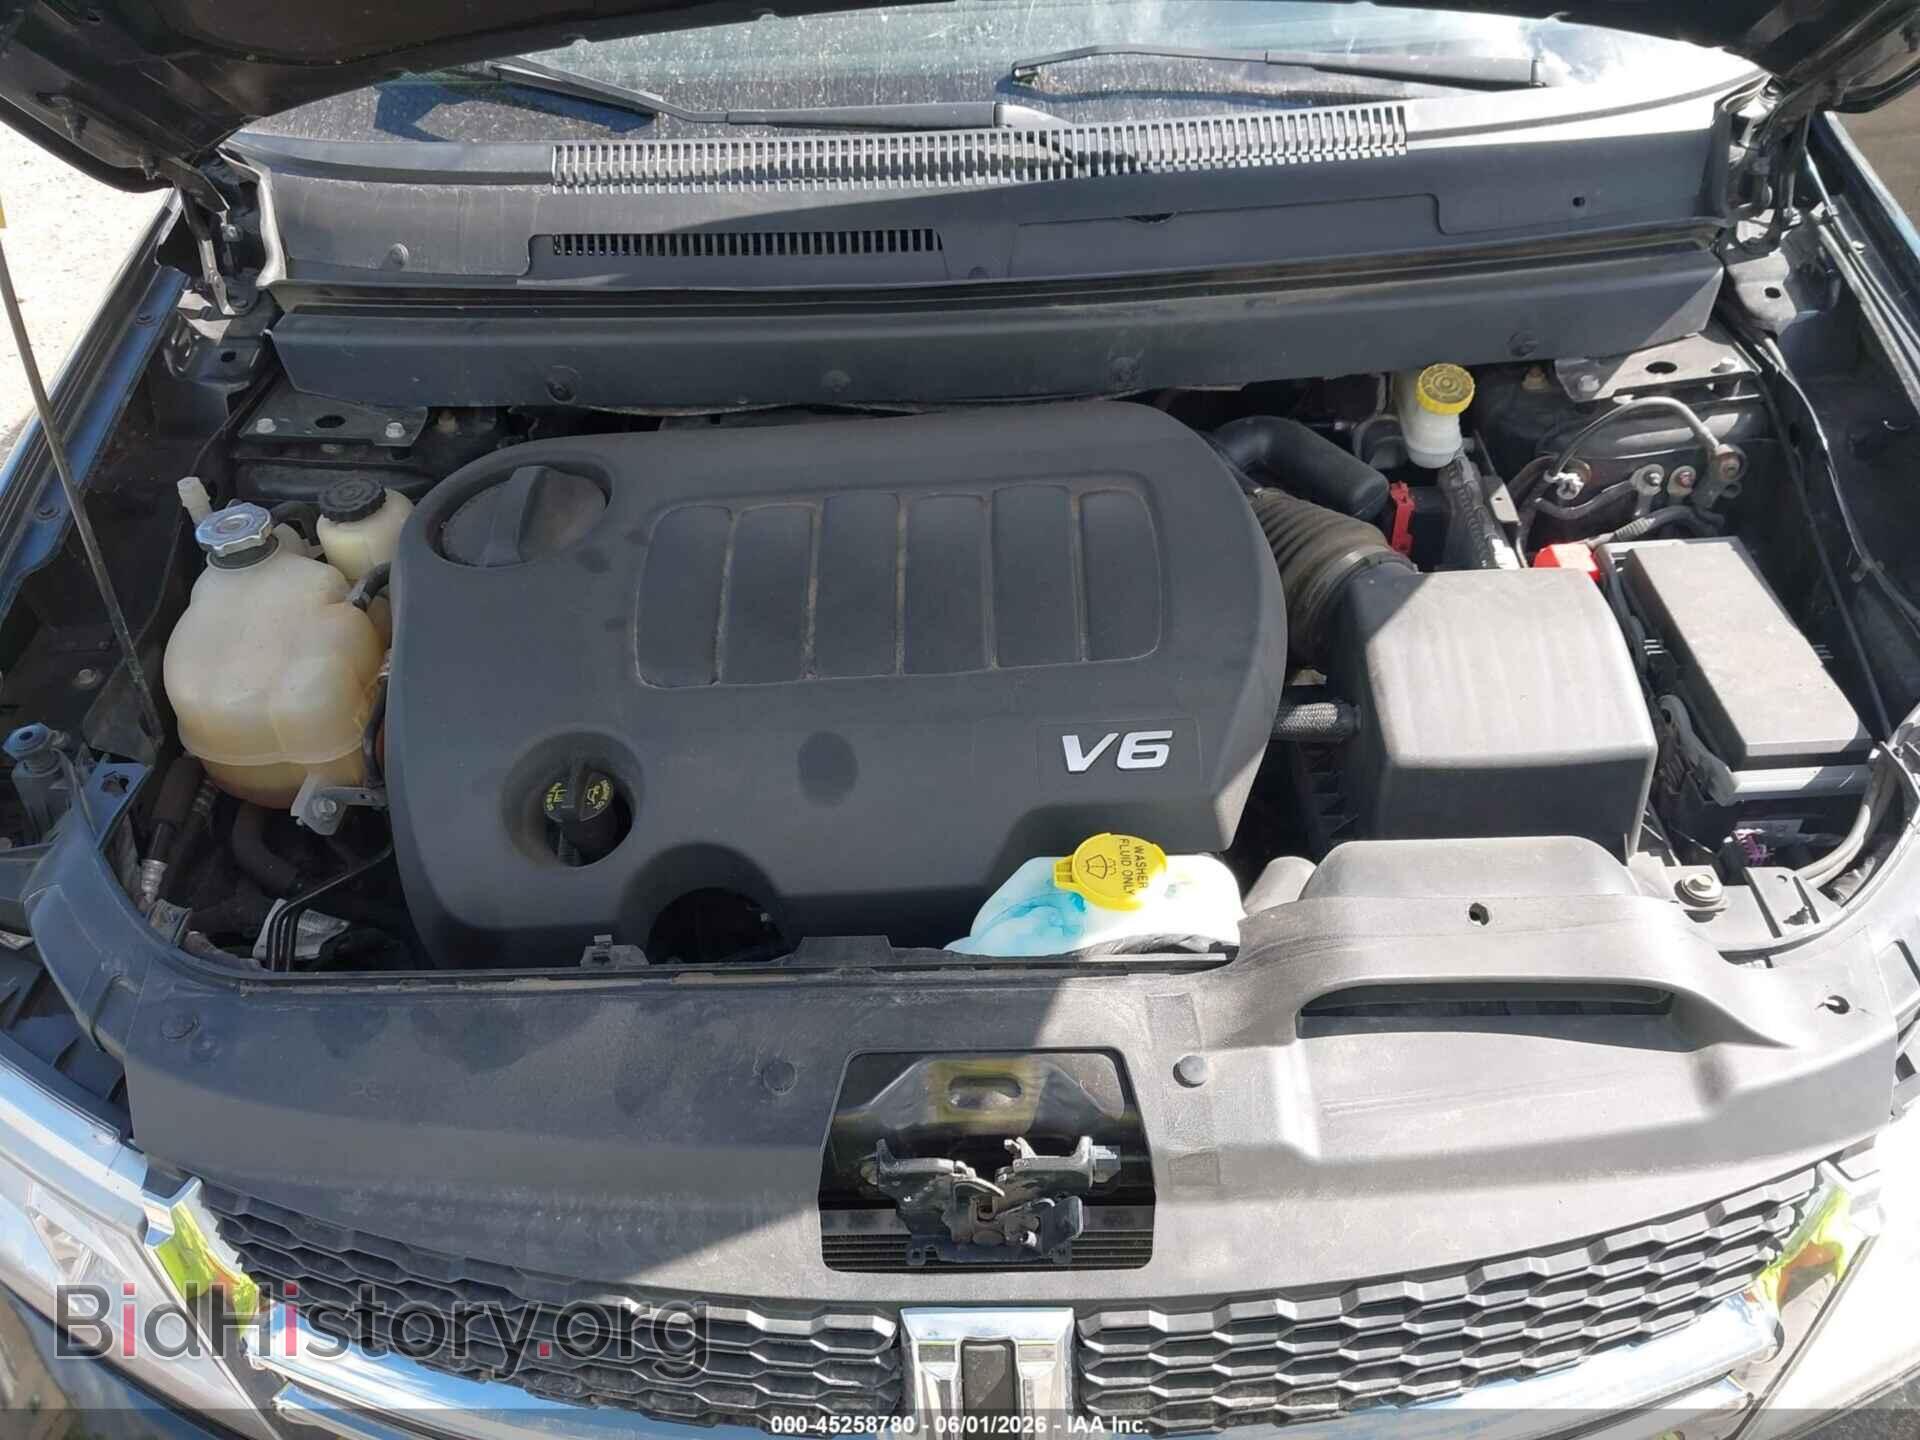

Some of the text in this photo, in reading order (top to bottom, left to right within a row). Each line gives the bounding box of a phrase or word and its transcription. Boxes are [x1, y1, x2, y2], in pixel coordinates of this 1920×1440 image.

[1062, 730, 1173, 771] V6
[1119, 838, 1135, 896] FLUID ONLY
[1134, 845, 1149, 889] WASHER
